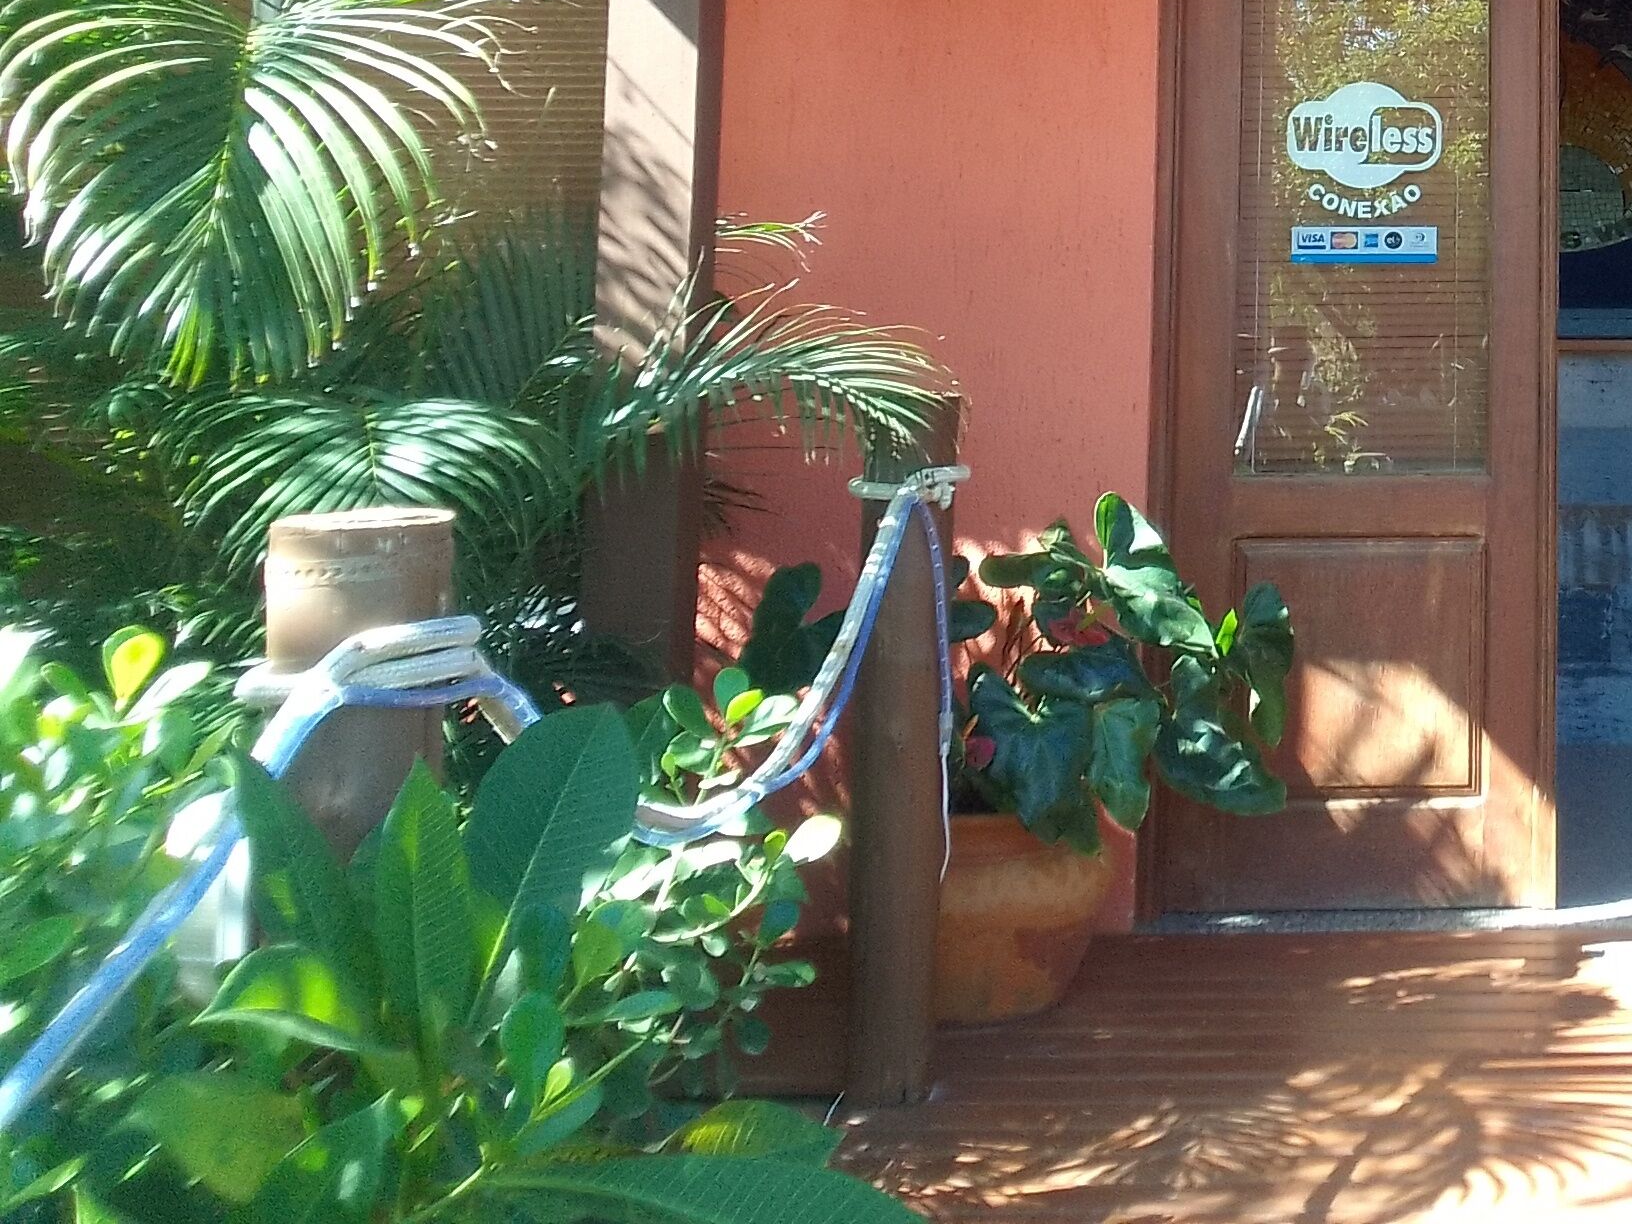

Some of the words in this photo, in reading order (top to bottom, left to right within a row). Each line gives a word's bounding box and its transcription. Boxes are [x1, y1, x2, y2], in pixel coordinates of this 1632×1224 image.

[1292, 114, 1433, 153] Wireless
[1308, 183, 1421, 218] CONEXÃO
[1301, 233, 1325, 244] VISA
